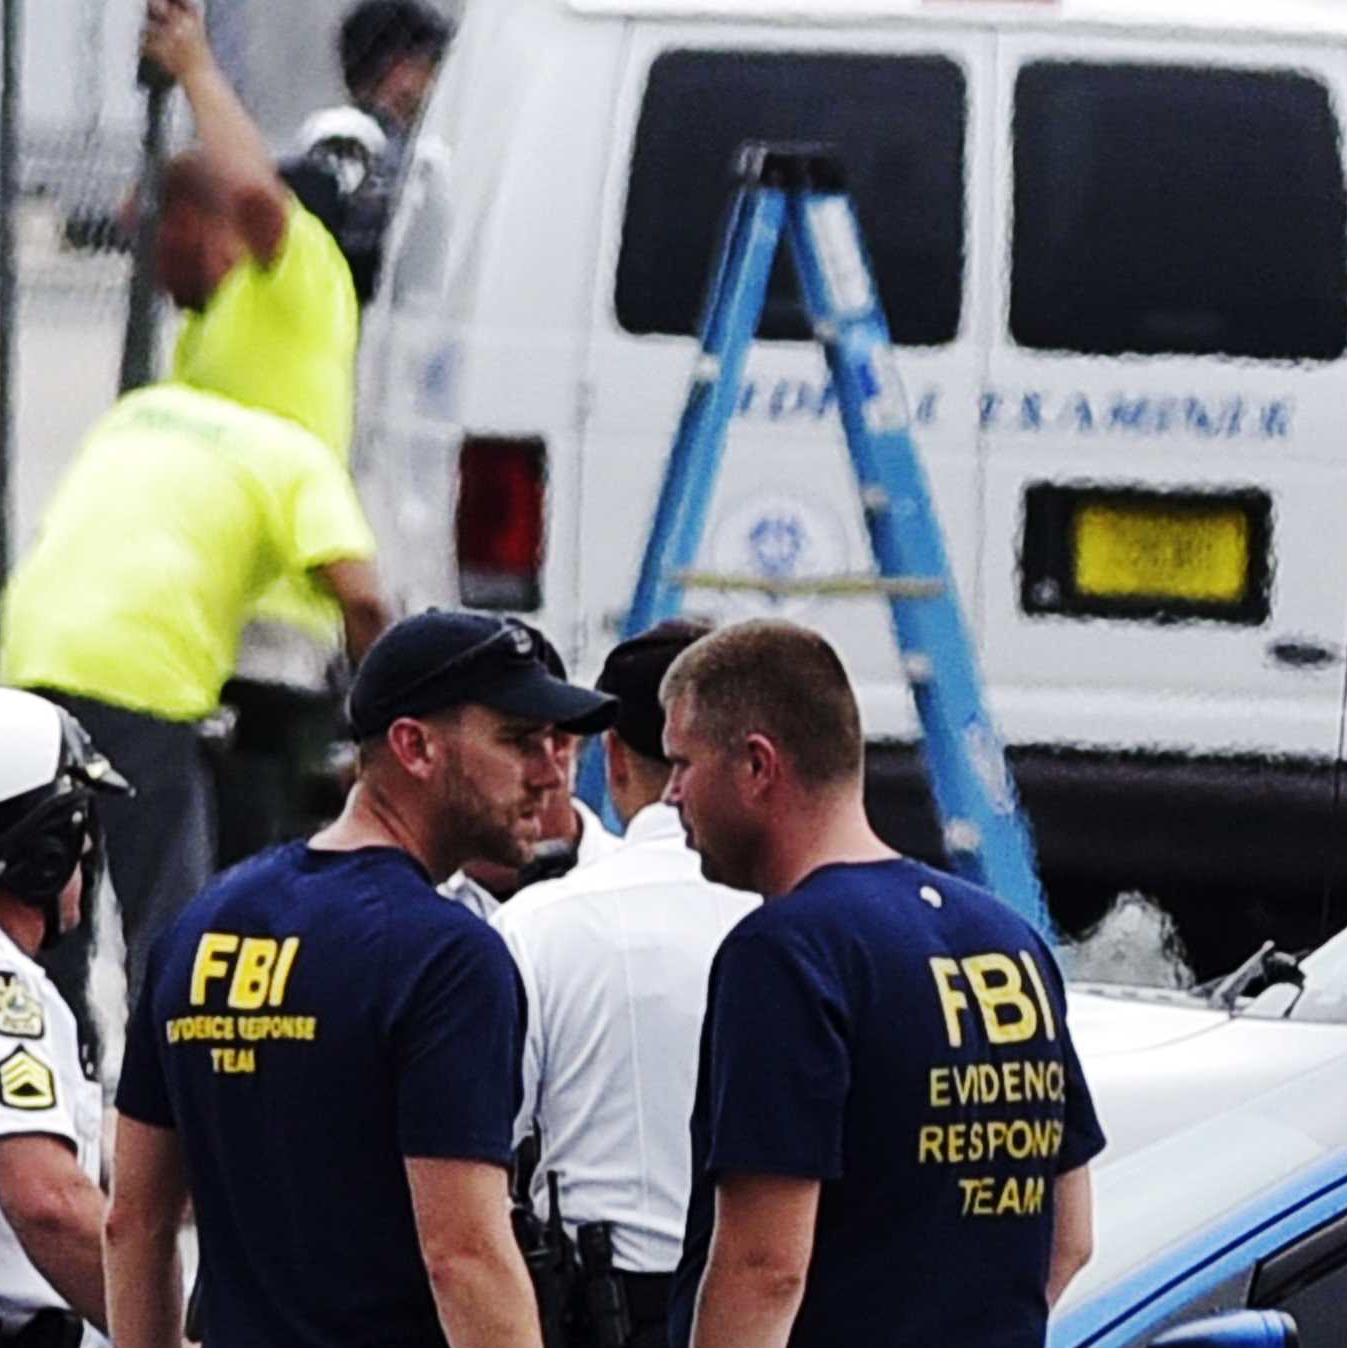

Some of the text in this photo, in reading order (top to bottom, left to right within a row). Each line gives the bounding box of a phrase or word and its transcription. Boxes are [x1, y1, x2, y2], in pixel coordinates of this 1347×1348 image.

[190, 932, 300, 1010] FBI
[929, 950, 1055, 1048] FBI
[958, 1175, 1045, 1216] TEAM
